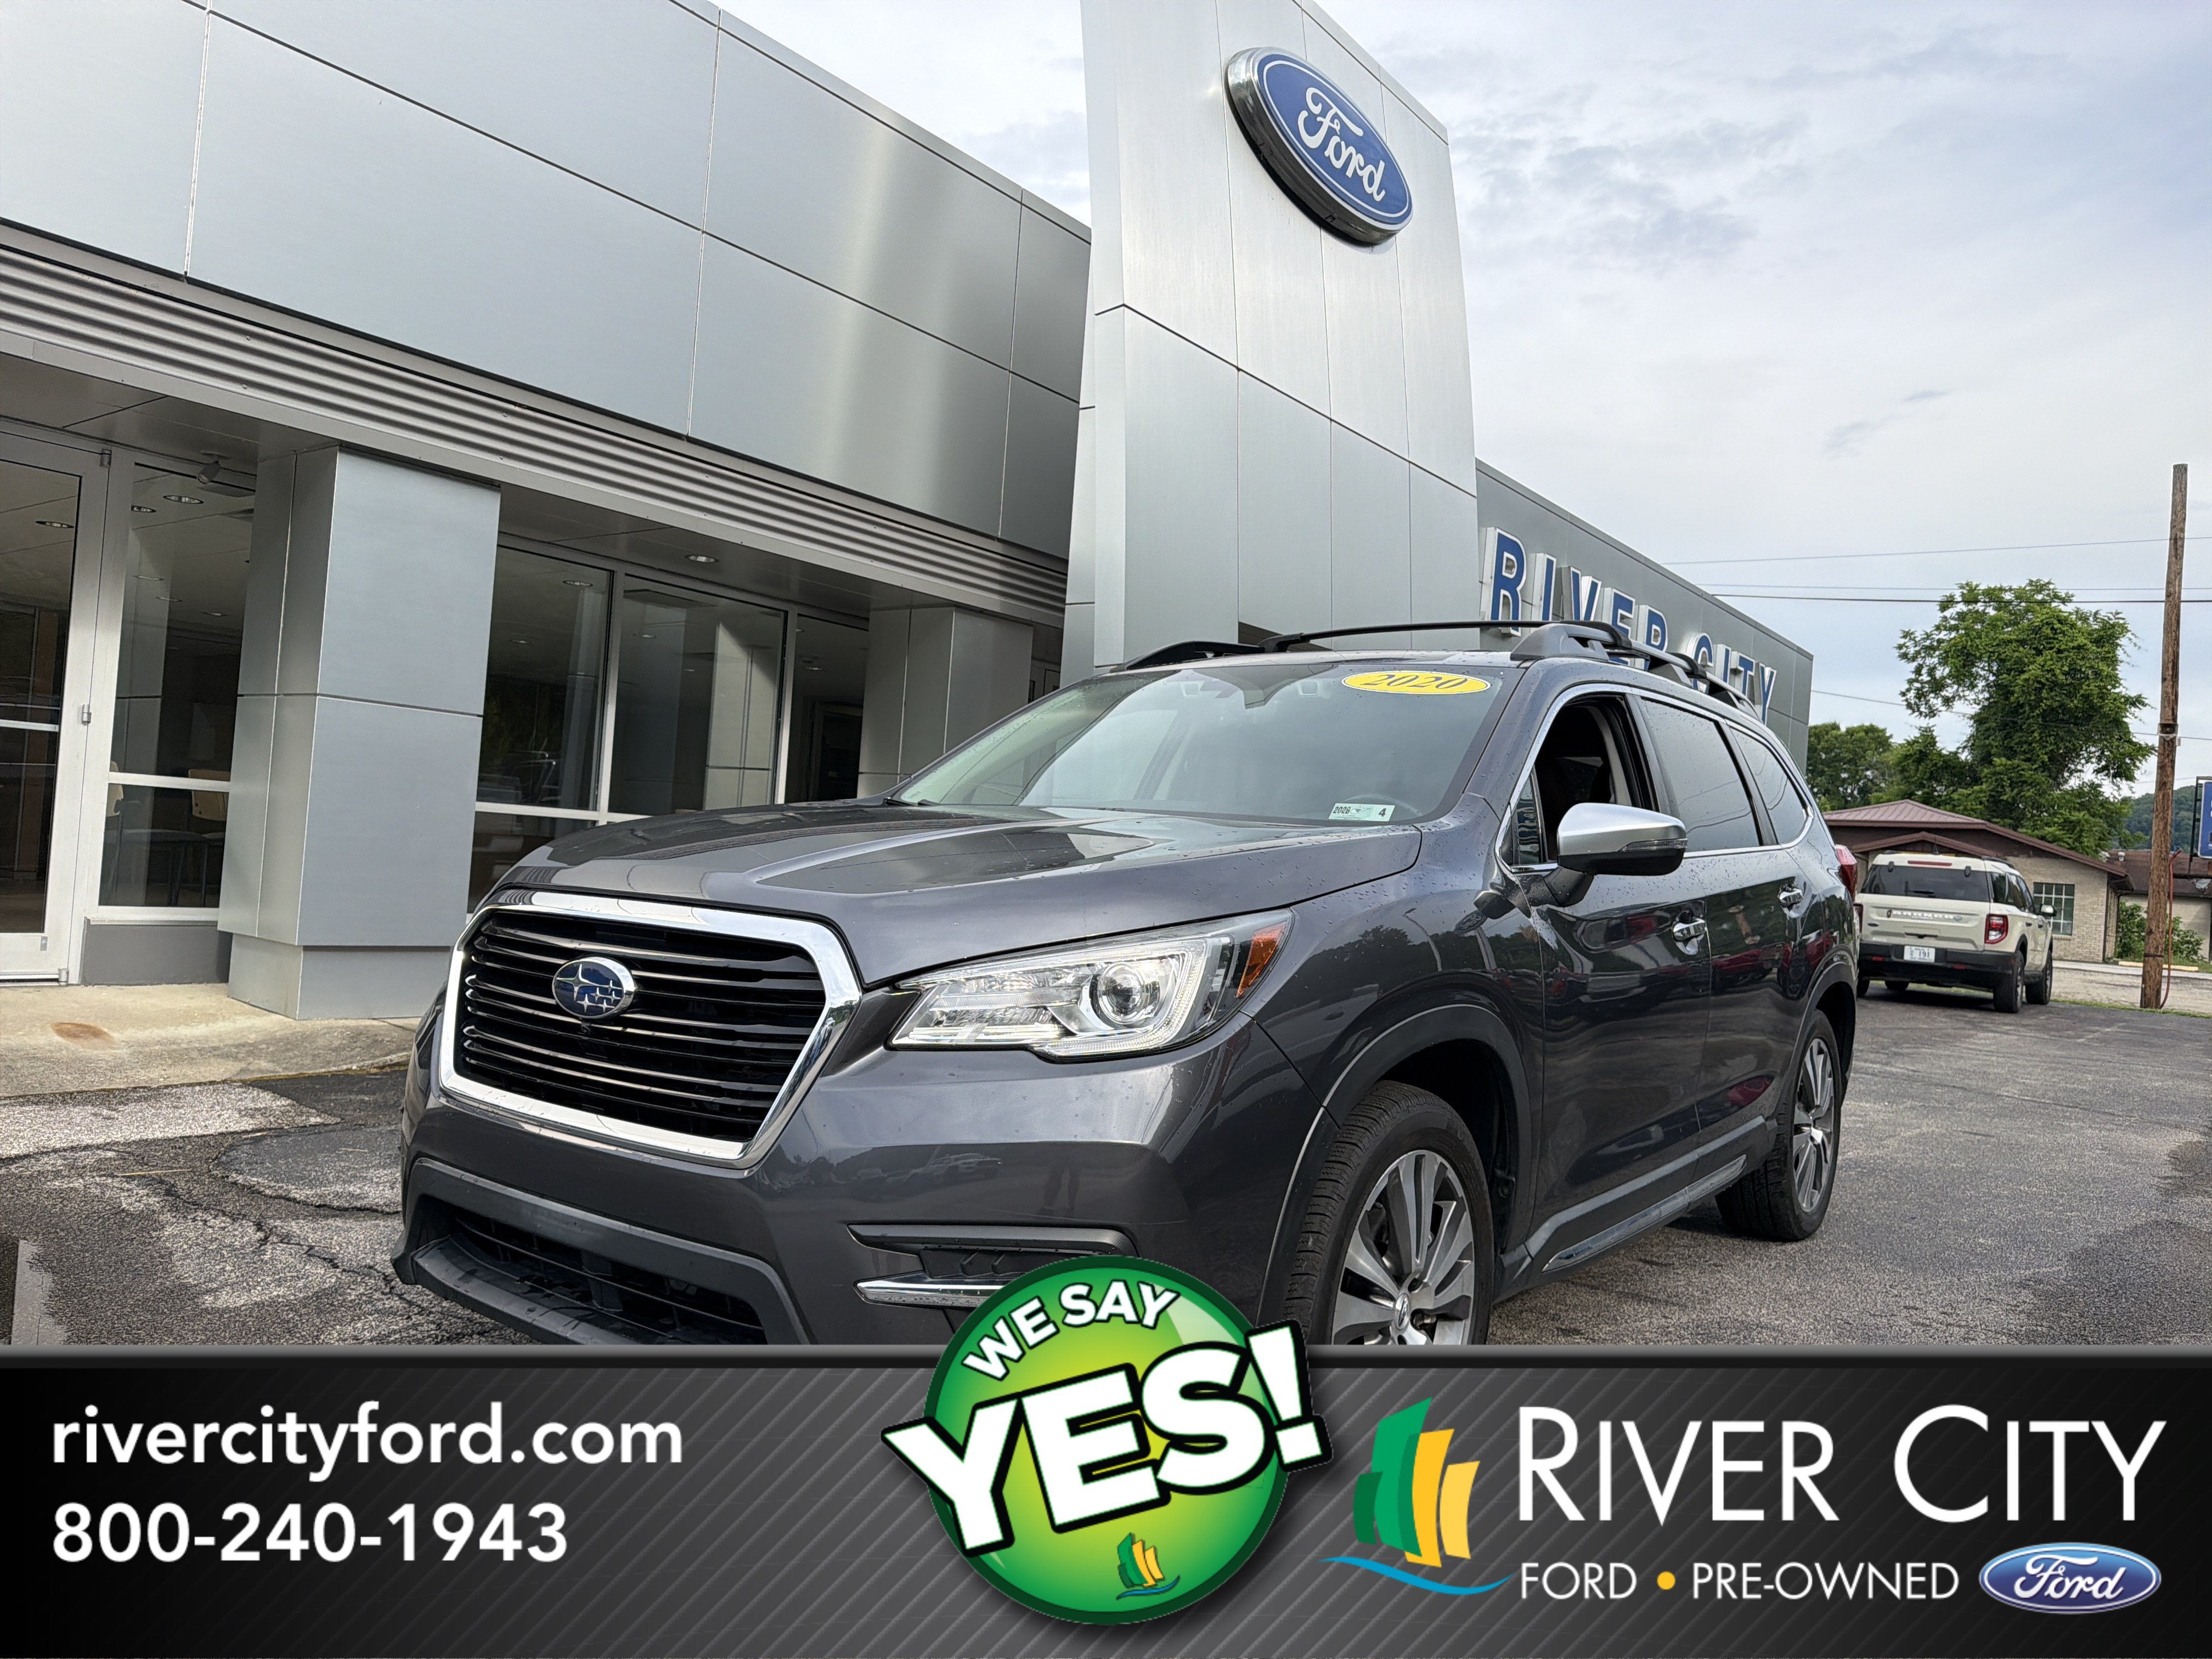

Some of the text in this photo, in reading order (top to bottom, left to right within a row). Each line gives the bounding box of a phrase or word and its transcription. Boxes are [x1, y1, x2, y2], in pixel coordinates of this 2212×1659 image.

[1298, 87, 1386, 202] Ford
[1481, 527, 1777, 725] RIVER CITY
[1359, 674, 1469, 690] 2020
[1378, 808, 1387, 817] 4
